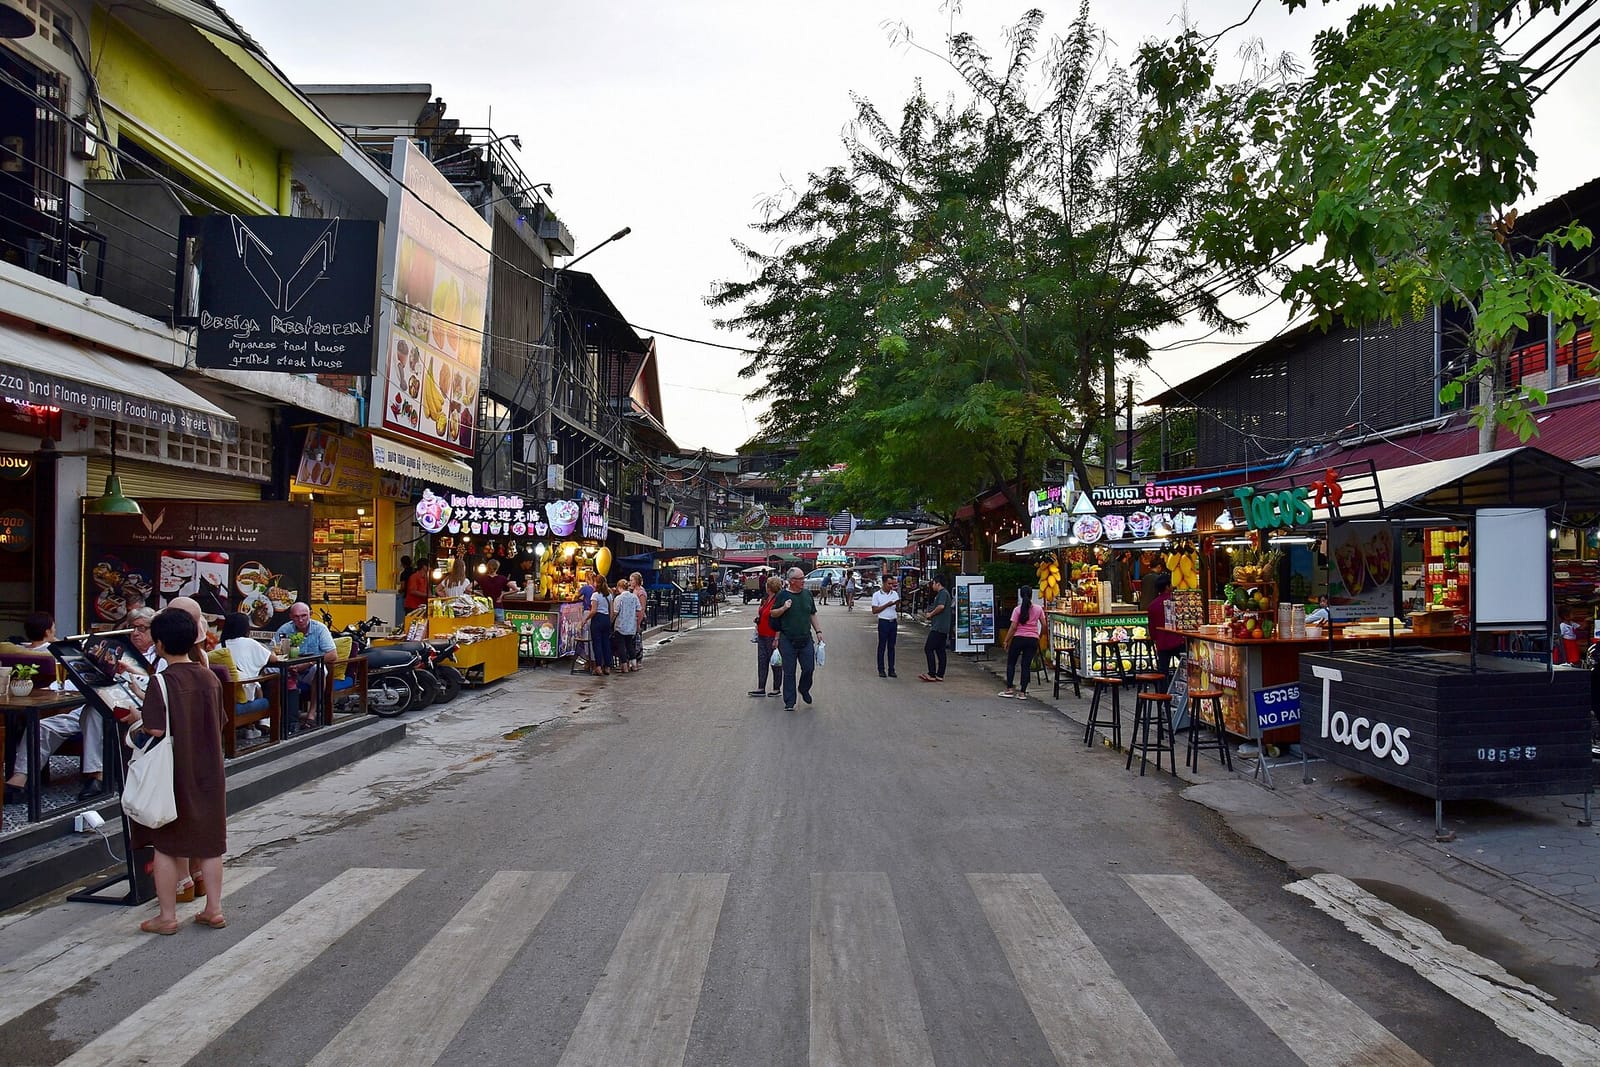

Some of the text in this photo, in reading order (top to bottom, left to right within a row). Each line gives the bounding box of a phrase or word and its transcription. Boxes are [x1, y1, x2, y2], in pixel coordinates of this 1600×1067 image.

[201, 309, 372, 338] Design Restaurant
[284, 341, 307, 351] food
[314, 341, 345, 353] house
[228, 353, 344, 368] grilled steak house
[29, 381, 50, 396] and
[91, 395, 122, 412] grilled
[149, 408, 158, 420] in
[161, 412, 176, 424] pub
[450, 494, 524, 509] Ice Cream Rolls
[1233, 486, 1313, 530] Tacos
[789, 515, 827, 528] STREET
[505, 612, 548, 621] Cream Rolls
[1258, 712, 1278, 726] NO
[1311, 665, 1411, 766] Tacos
